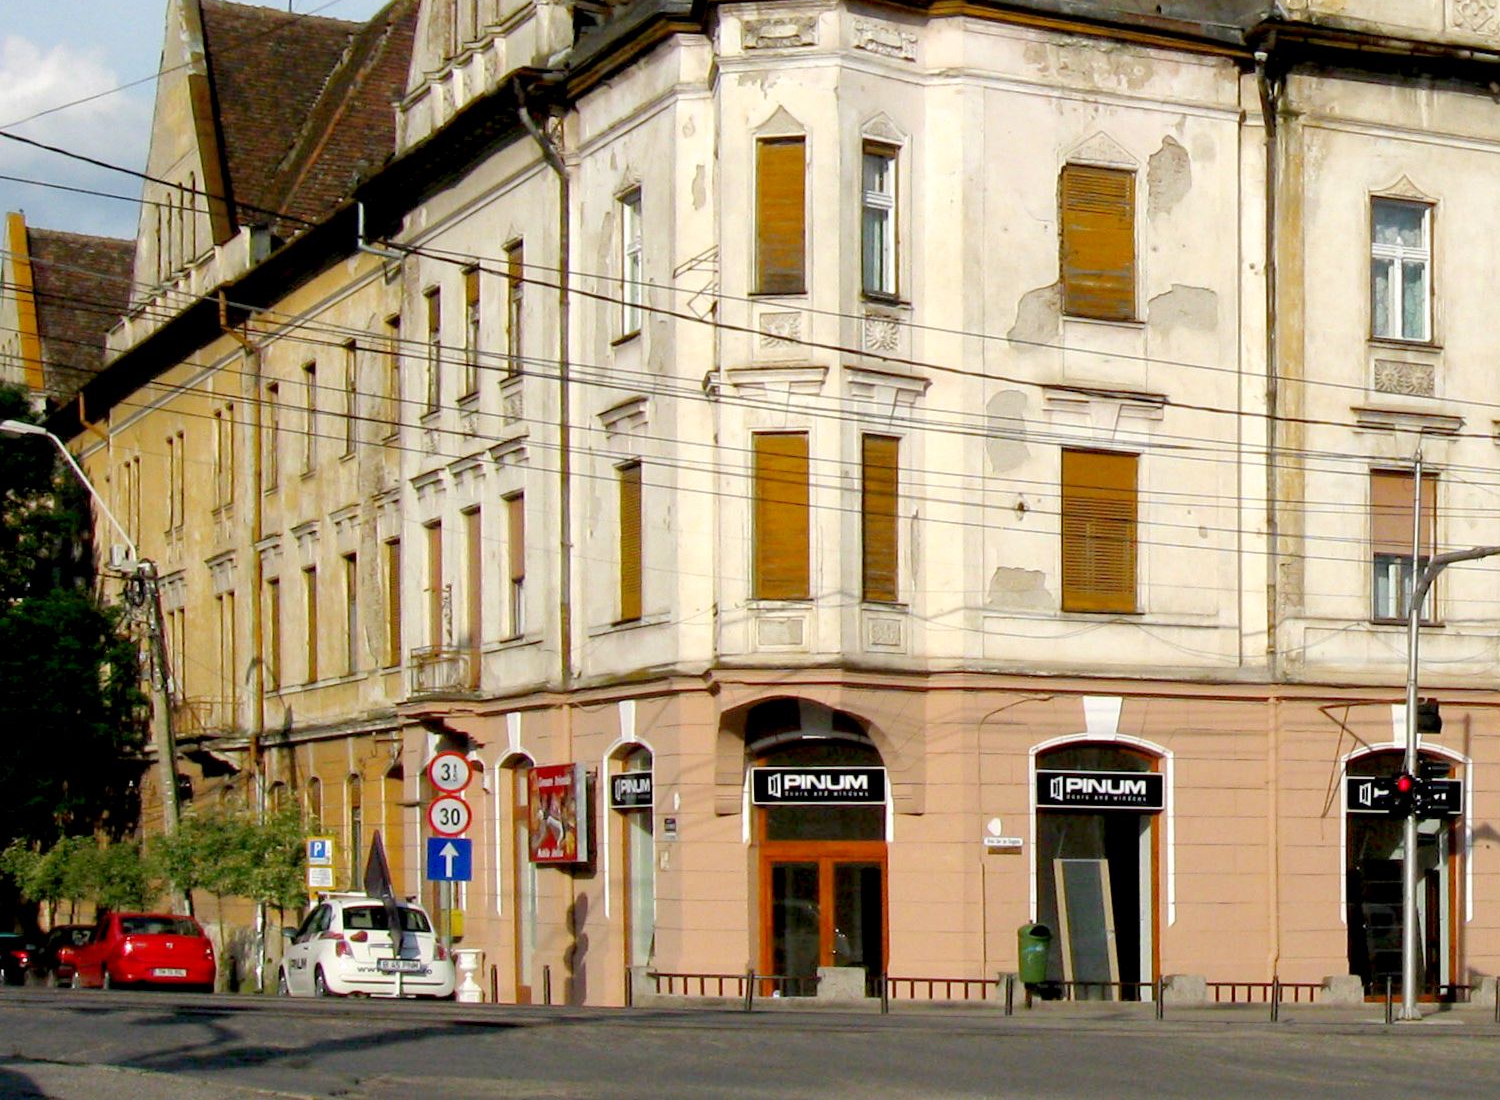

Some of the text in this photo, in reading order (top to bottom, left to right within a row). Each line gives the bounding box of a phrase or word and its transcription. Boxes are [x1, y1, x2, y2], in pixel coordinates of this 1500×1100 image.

[621, 778, 651, 794] PINUM
[785, 775, 868, 790] PINUM
[1066, 778, 1147, 795] PINUM
[439, 808, 461, 826] 30
[313, 842, 322, 856] P
